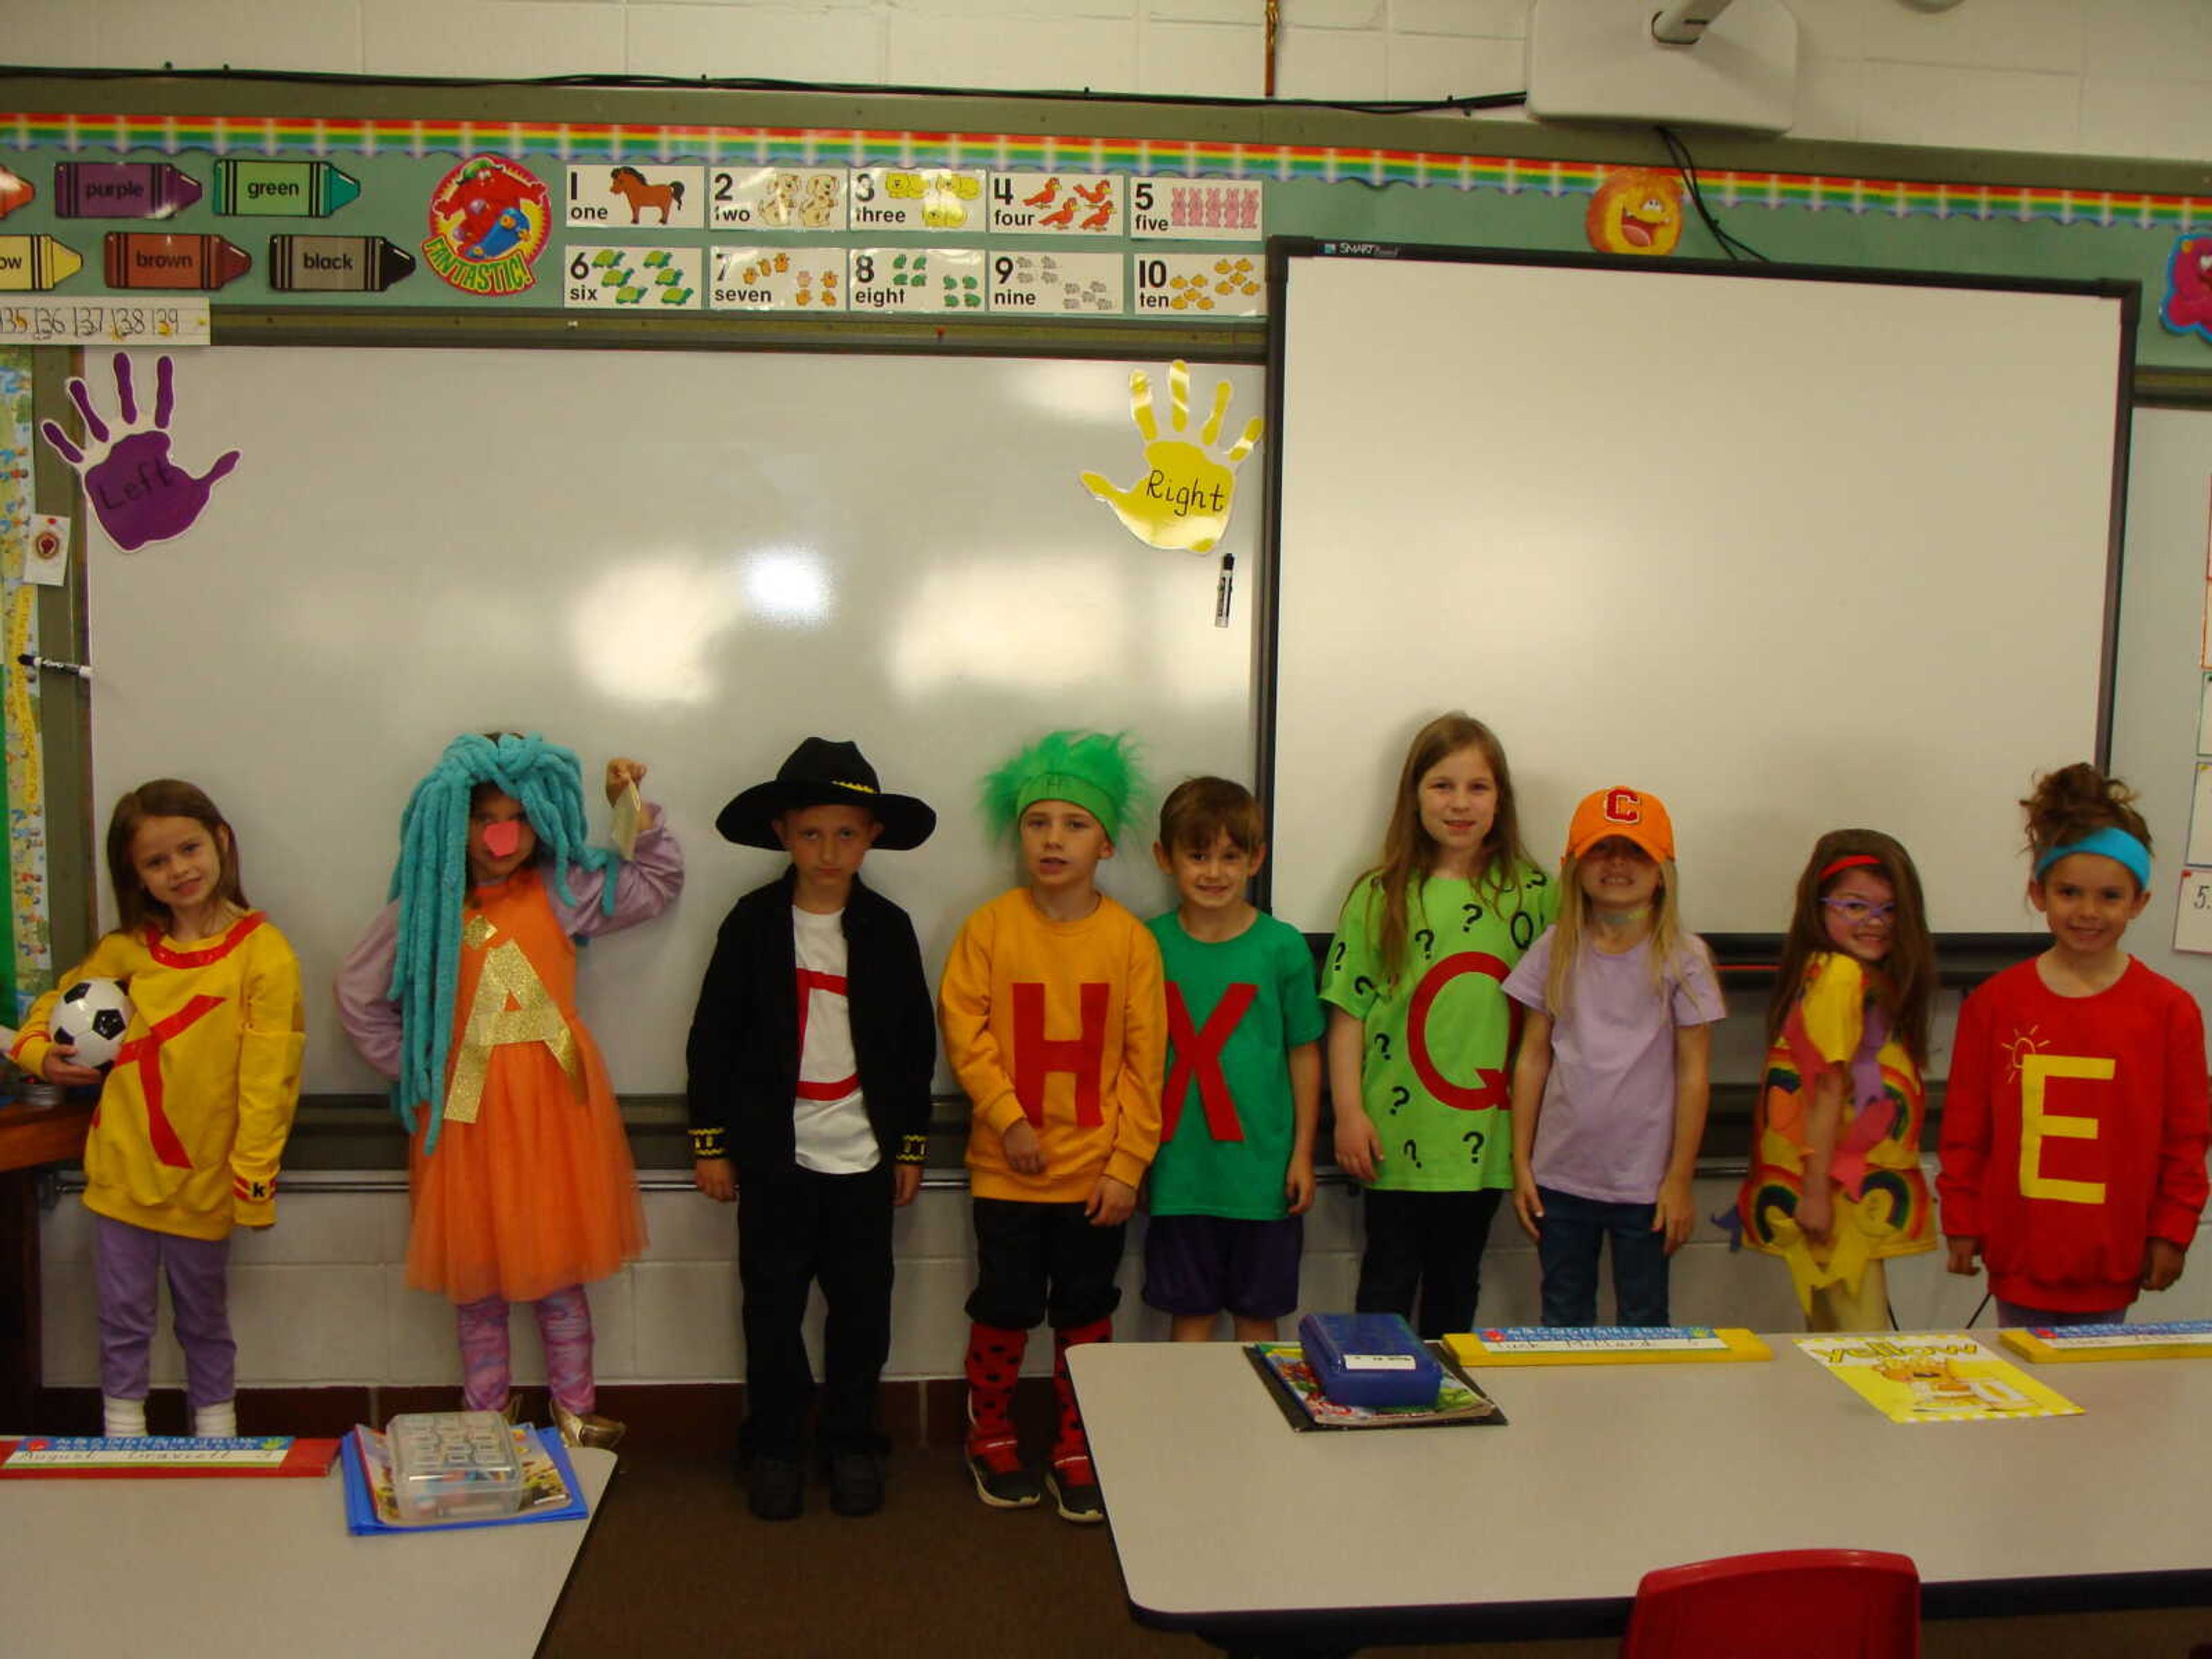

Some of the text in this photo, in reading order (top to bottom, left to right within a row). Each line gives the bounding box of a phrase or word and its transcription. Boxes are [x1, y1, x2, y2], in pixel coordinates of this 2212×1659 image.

[86, 181, 143, 200] purple
[247, 181, 300, 199] green
[714, 173, 733, 202] 2
[855, 173, 875, 202] 3
[994, 177, 1014, 205] 4
[1135, 183, 1153, 210] 5
[570, 206, 608, 221] one
[714, 205, 751, 222] two
[855, 206, 906, 224] three
[994, 210, 1035, 226] four
[1135, 215, 1169, 232] five
[135, 250, 193, 269] brown
[303, 252, 354, 271] black
[1339, 242, 1375, 255] SMART
[424, 237, 533, 291] FANTASTIC!
[570, 251, 589, 279] 6
[715, 253, 730, 282] 7
[855, 255, 875, 283] 8
[995, 256, 1014, 285] 9
[1139, 259, 1167, 287] 10
[570, 286, 598, 301] six
[714, 289, 772, 303] seven
[855, 287, 906, 308] eight
[994, 290, 1036, 305] nine
[1139, 294, 1169, 308] ten
[73, 306, 104, 336] 137
[99, 457, 173, 510] Left
[1146, 469, 1225, 517] Right
[1604, 788, 1640, 824] C
[443, 937, 576, 1124] A
[1406, 950, 1524, 1111] Q
[1012, 982, 1111, 1128] H
[1161, 980, 1260, 1142] X
[2019, 1054, 2116, 1205] E
[253, 1182, 265, 1198] k
[1811, 1342, 1978, 1363] yellow
